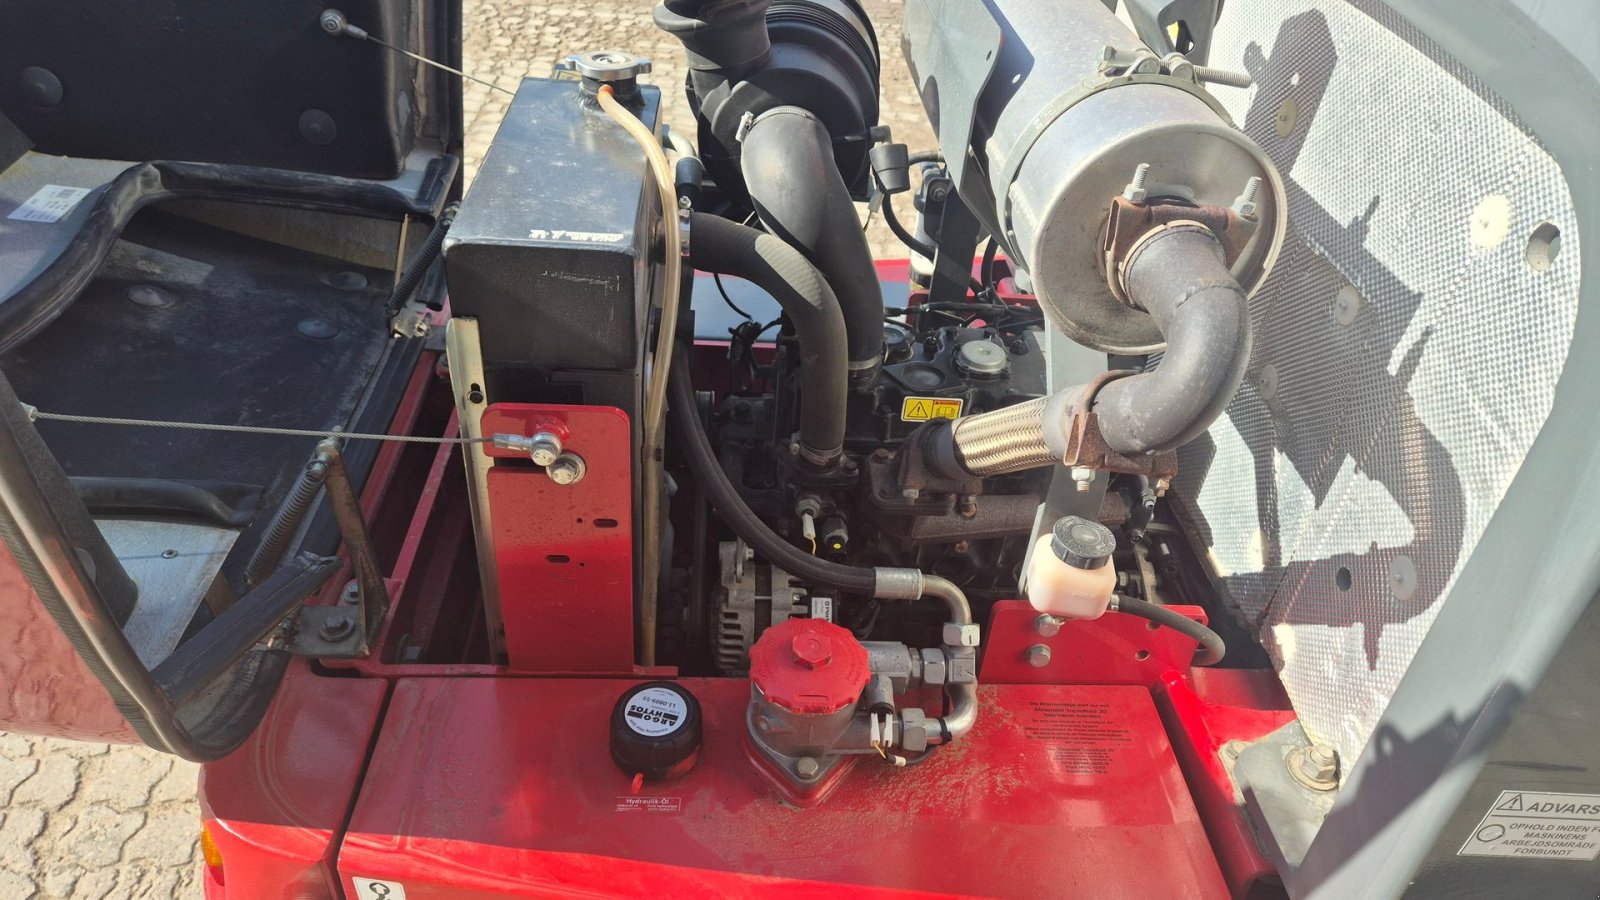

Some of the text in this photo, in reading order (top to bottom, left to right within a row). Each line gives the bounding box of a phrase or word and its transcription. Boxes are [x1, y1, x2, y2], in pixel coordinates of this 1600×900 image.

[630, 704, 663, 718] HYTOS
[643, 714, 676, 727] ARGO
[1526, 802, 1600, 815] ADVARS
[1509, 823, 1555, 831] OPHOLD
[1556, 825, 1589, 833] INDEN
[1523, 832, 1588, 840] MASKINENS
[1514, 848, 1573, 856] FORBUNDT
